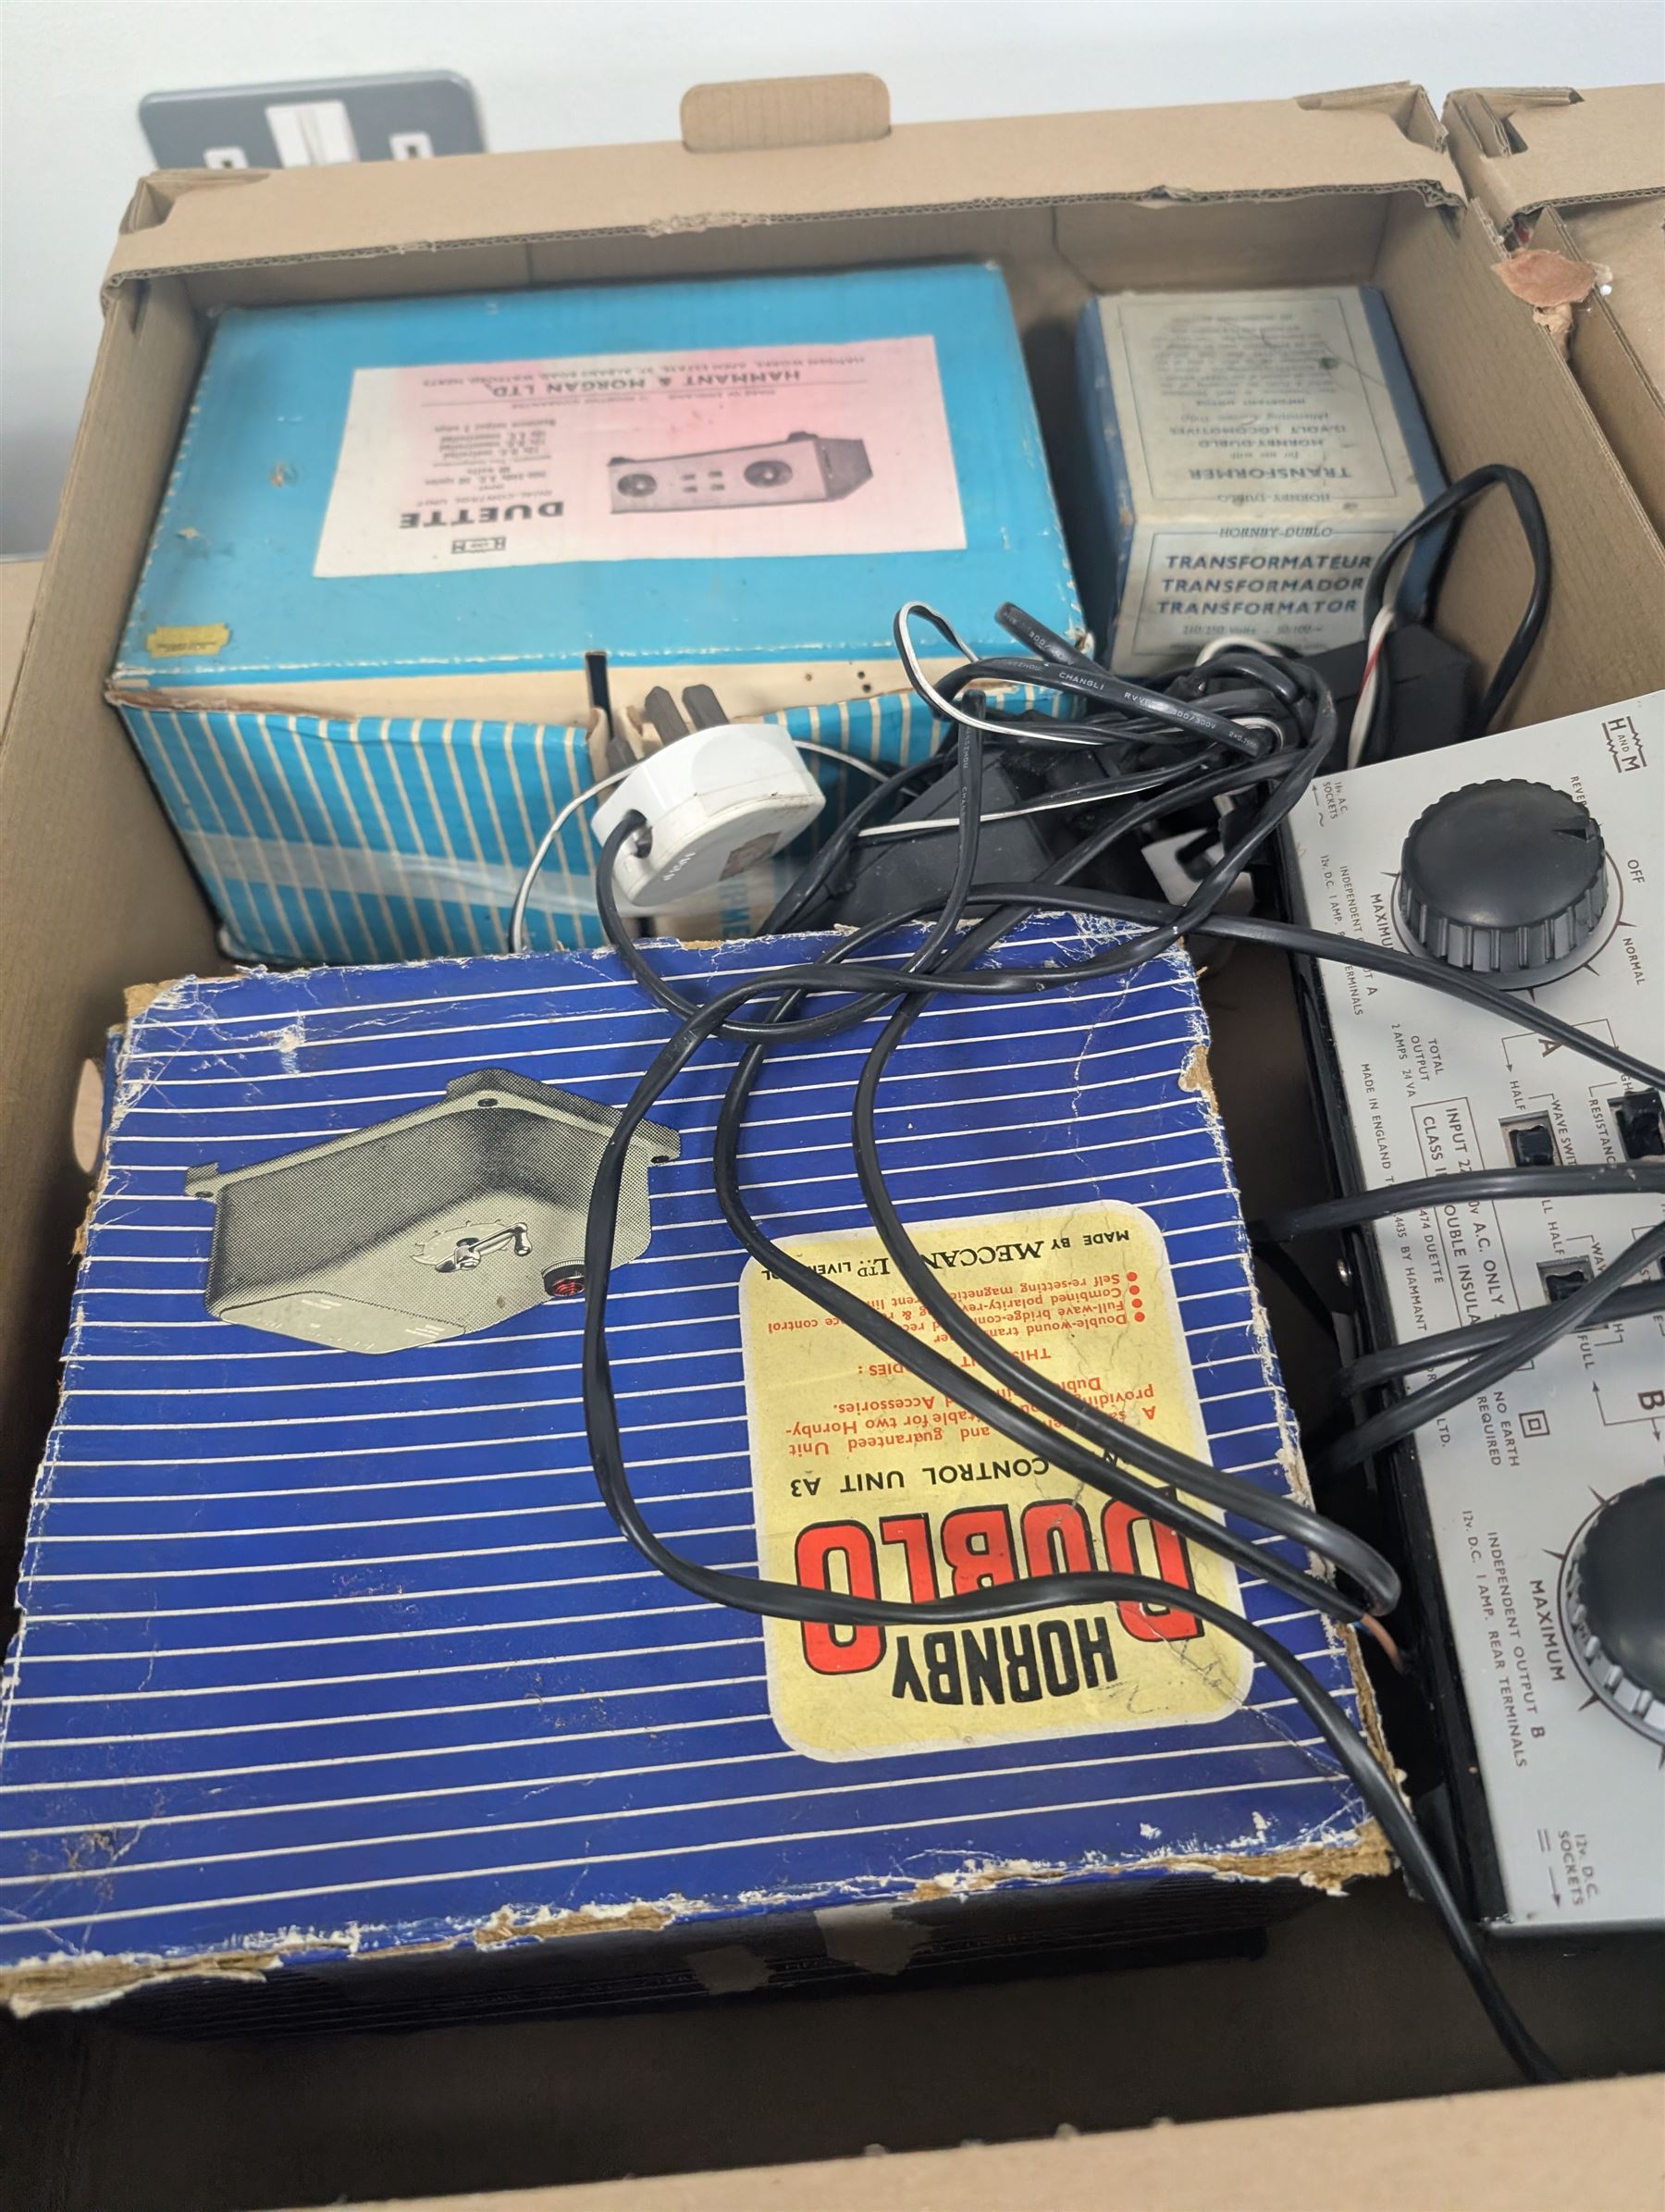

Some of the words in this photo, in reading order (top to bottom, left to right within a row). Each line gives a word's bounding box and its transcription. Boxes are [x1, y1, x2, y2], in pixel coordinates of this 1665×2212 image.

[547, 379, 646, 394] MORGAN
[658, 377, 672, 388] &
[685, 370, 799, 387] HAMMANT
[1189, 467, 1350, 480] TRANSFORMER
[400, 501, 563, 528] DUETTE
[1219, 526, 1332, 538] HORNBY-DUBLO
[1166, 555, 1373, 570] TRANSFORMATEUR
[1163, 577, 1364, 593] TRANSFORMADOR
[1158, 599, 1357, 615] TRANSFORMATOR
[1058, 671, 1105, 691] CHANGLI
[1617, 734, 1630, 752] AND
[1323, 781, 1338, 820] SOCKETS
[1627, 859, 1645, 884] OFF
[1338, 866, 1363, 933] INDEPENDENT
[1366, 987, 1378, 995] A
[1370, 894, 1393, 950] MAXIMU
[1622, 937, 1645, 985] NORMAL
[1344, 964, 1363, 1016] ERMINALS
[1393, 1032, 1408, 1060] AMPS
[1428, 1038, 1443, 1075] TOTAL
[1537, 1038, 1562, 1057] A
[1411, 1035, 1429, 1081] OUTPUT
[1362, 1063, 1375, 1094] MADE
[1402, 1069, 1412, 1080] 24
[1406, 1082, 1415, 1097] VA
[1510, 1081, 1526, 1111] HALF
[1368, 1098, 1378, 1110] IN
[1373, 1116, 1391, 1169] ENGLAND
[1550, 1099, 1567, 1134] WAVE
[1561, 1137, 1577, 1166] SWIT
[1589, 1099, 1616, 1166] RESISTANC
[1446, 1107, 1467, 1153] INPUT
[1473, 1222, 1490, 1253] A.C.
[1484, 1260, 1504, 1304] ONLY
[1423, 1116, 1443, 1160] CLASS
[1444, 1205, 1467, 1256] OUBLE
[1457, 1265, 1480, 1325] INSULA
[1051, 1238, 1070, 1250] BY
[1082, 1230, 1129, 1245] MADE
[920, 1240, 1044, 1270] MECCAN
[1400, 1245, 1412, 1260] BY
[1424, 1235, 1444, 1284] DUETTE
[1020, 1279, 1086, 1293] re-setting
[1093, 1274, 1119, 1287] Self
[1050, 1288, 1121, 1305] Combined
[1404, 1267, 1427, 1331] HAMMANT
[1548, 1221, 1564, 1255] HALF
[1577, 1335, 1595, 1370] FULL
[902, 1310, 912, 1320] &
[1058, 1301, 1124, 1317] Full-wave
[768, 1319, 818, 1333] control
[1026, 1314, 1127, 1336] Double-wound
[833, 1396, 934, 1415] Accessories.
[1494, 1390, 1507, 1414] NO
[1638, 1390, 1664, 1410] B
[865, 1416, 896, 1429] two
[904, 1415, 928, 1427] for
[1142, 1406, 1156, 1420] A
[785, 1420, 857, 1439] Hornby-
[847, 1427, 943, 1452] guaranteed
[959, 1427, 990, 1441] and
[1477, 1396, 1501, 1466] REQUIRED
[789, 1442, 829, 1456] Unit
[1500, 1421, 1520, 1466] EARTH
[840, 1470, 905, 1493] UNIT
[921, 1457, 1050, 1485] CONTROL
[790, 1477, 821, 1497] A3
[794, 1484, 1204, 1676] DUBLO
[1486, 1532, 1521, 1638] INDEPENDENT
[1512, 1646, 1537, 1714] OUTPUT
[1531, 1726, 1546, 1738] B
[1529, 1579, 1566, 1681] MAXIMUM
[892, 1617, 1117, 1706] HORNBY
[1477, 1585, 1495, 1620] AMP.
[1488, 1631, 1506, 1669] REAR
[1498, 1676, 1527, 1768] TERMINALS
[1558, 1830, 1584, 1906] SOCKETS
